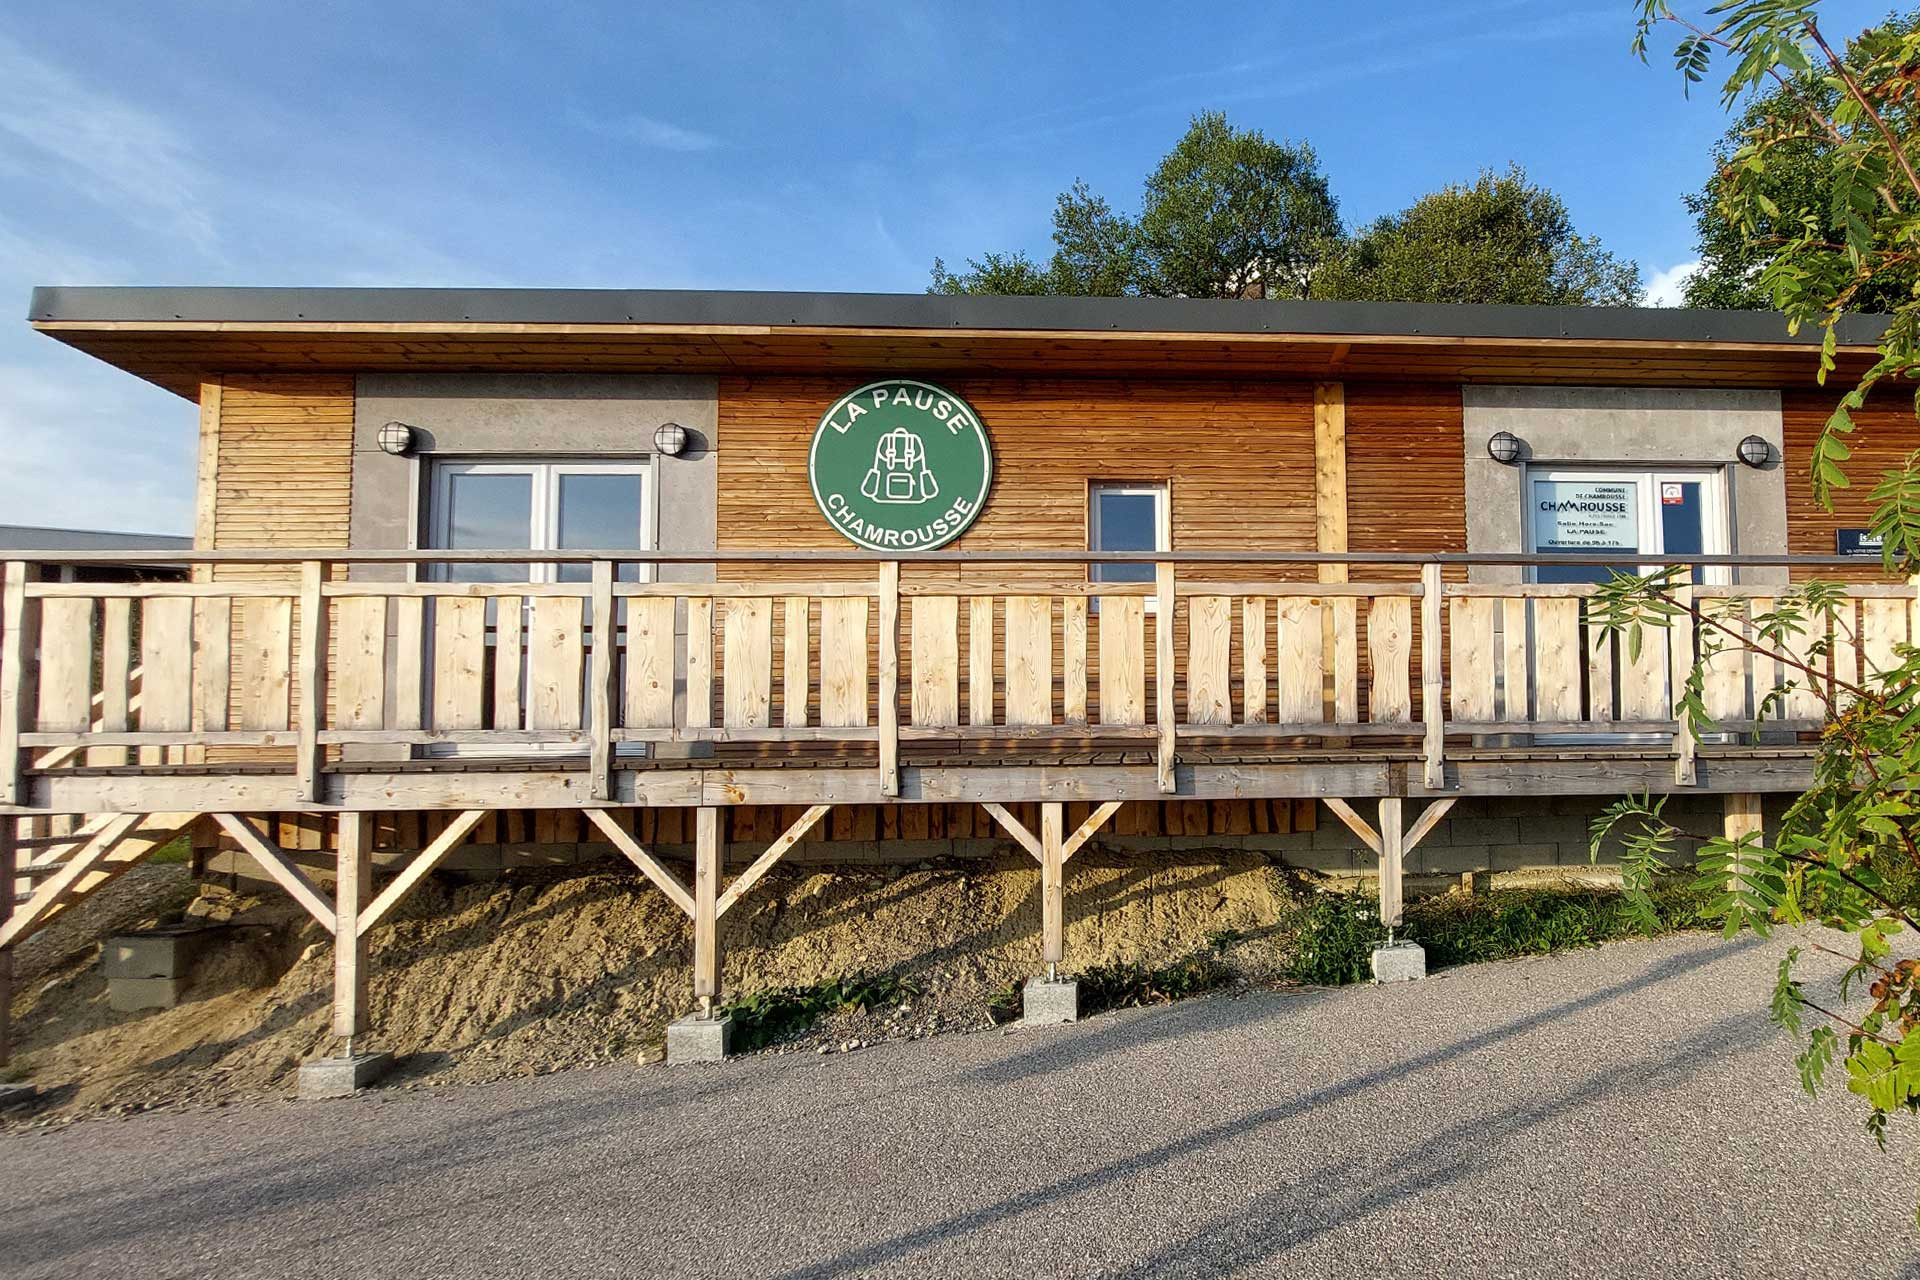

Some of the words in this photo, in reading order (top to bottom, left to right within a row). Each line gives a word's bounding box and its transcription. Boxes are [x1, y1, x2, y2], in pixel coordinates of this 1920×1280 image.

[829, 402, 868, 434] LA
[872, 387, 970, 435] PAUSE
[827, 493, 973, 547] CHAMROUSSE
[1540, 500, 1626, 512] CHAMROUSSE
